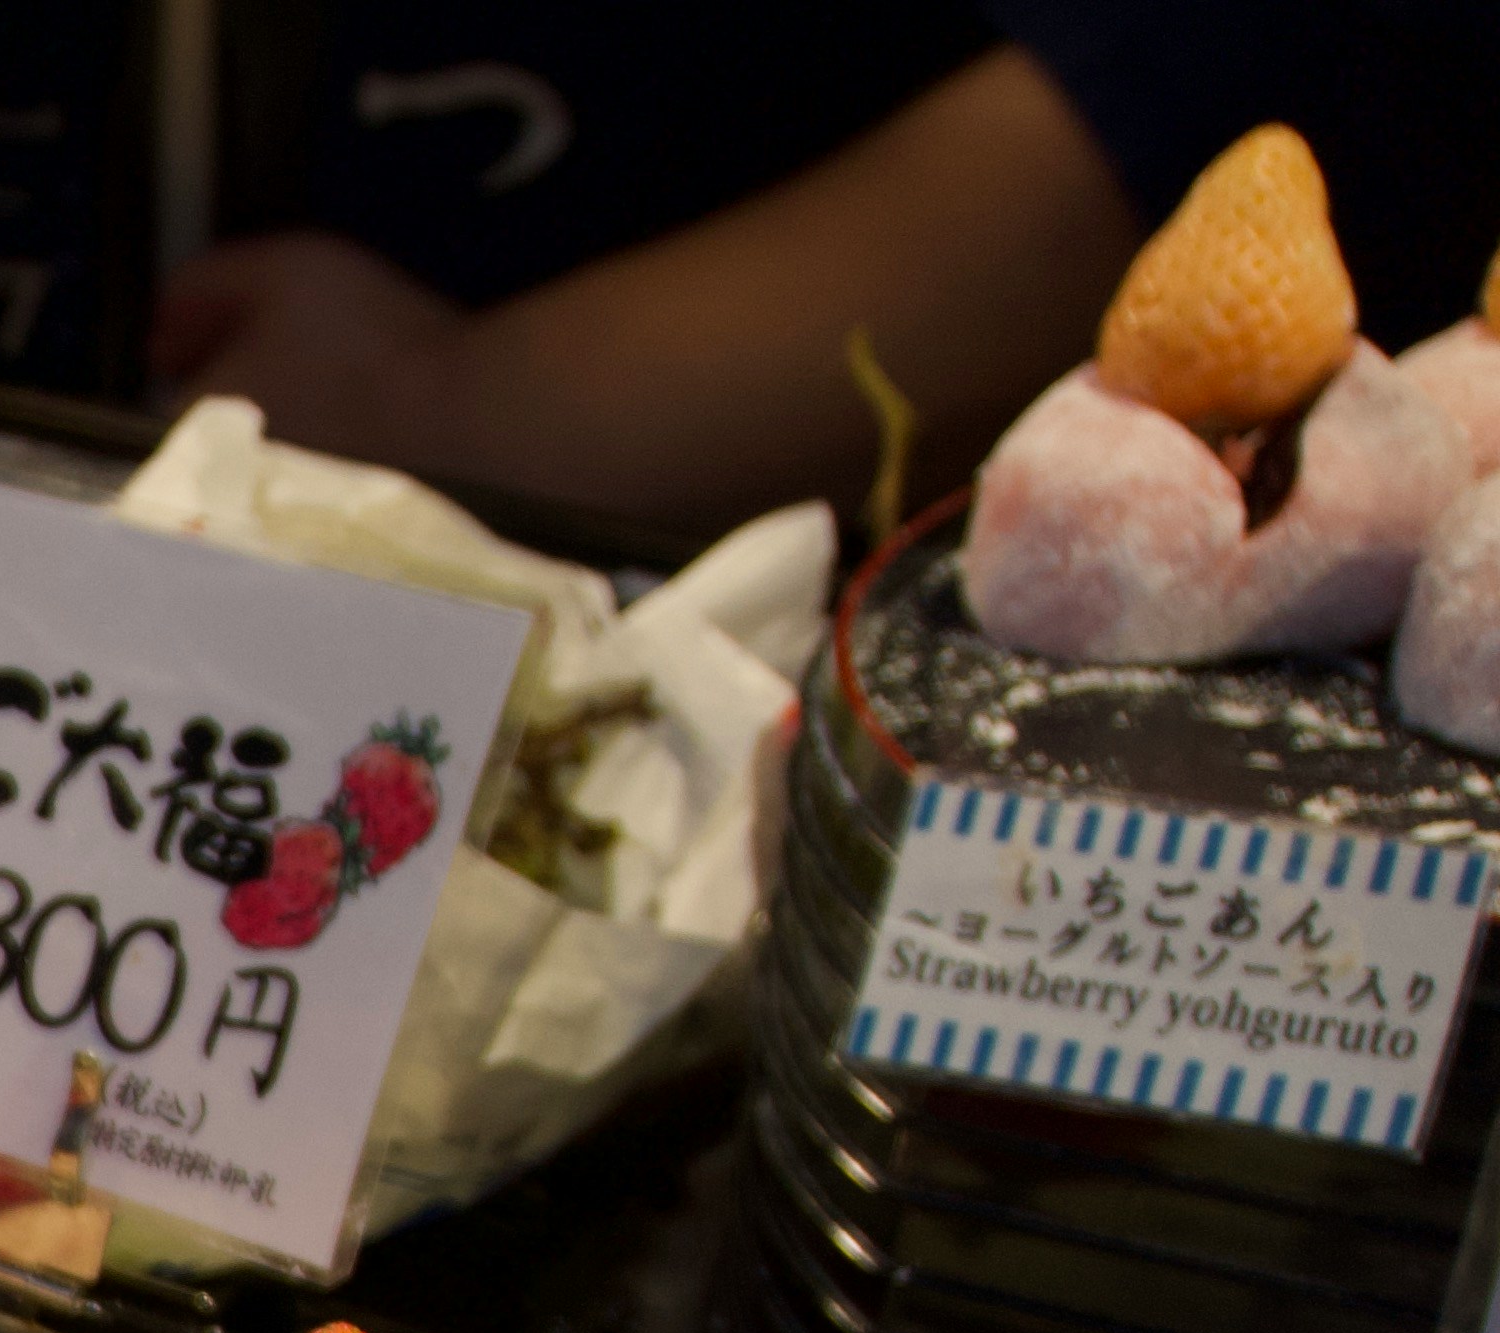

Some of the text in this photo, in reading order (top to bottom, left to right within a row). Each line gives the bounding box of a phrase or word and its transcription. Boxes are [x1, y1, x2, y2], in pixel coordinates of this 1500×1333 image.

[1016, 864, 1332, 951] いちごあん
[887, 938, 1420, 1061] Strawberry yohguruto
